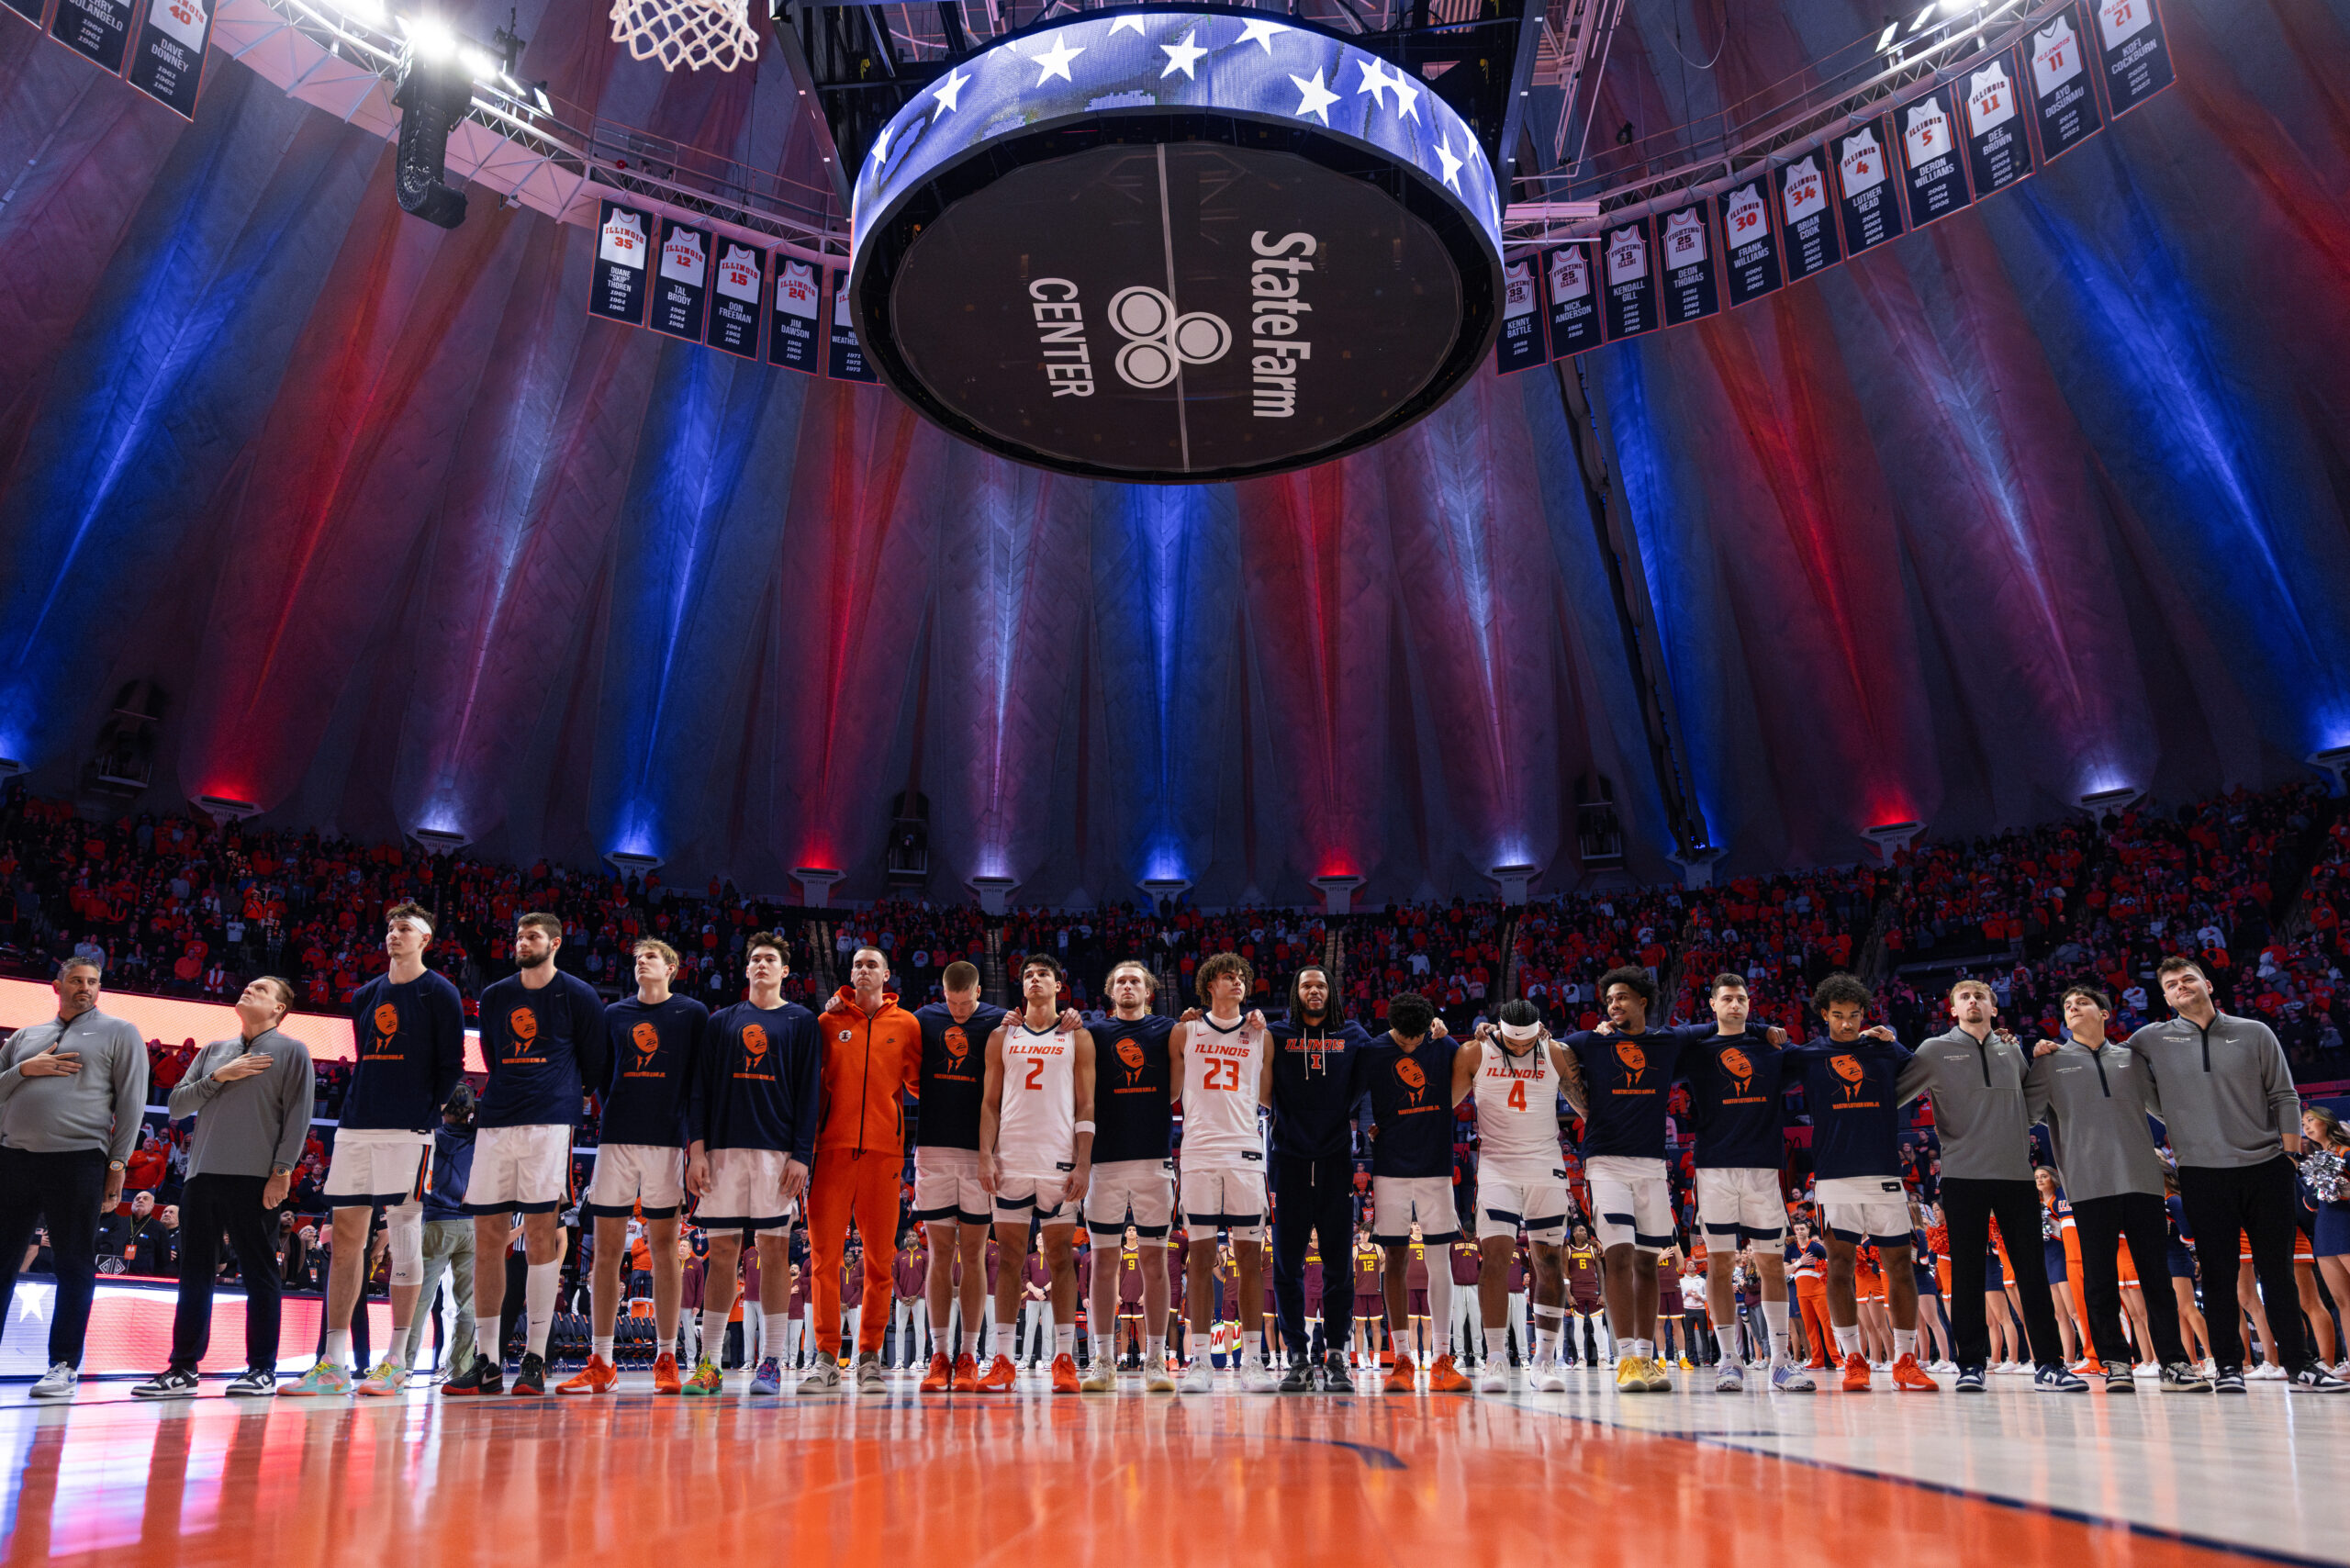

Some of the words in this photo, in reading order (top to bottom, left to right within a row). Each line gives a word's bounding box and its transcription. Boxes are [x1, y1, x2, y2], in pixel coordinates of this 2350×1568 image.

[169, 6, 191, 25] 40
[2113, 4, 2132, 28] 21
[161, 38, 184, 59] DAVE
[2037, 37, 2070, 63] ILLINOIS
[2122, 38, 2142, 57] KOFI
[151, 43, 188, 73] DOWNEY
[2049, 51, 2064, 73] 11
[2111, 39, 2157, 75] COCKBURN
[1973, 81, 2005, 104] ILLINOIS
[2055, 84, 2070, 102] AYO
[1981, 94, 2000, 116] 11
[2045, 86, 2085, 118] DOSUNMU
[1909, 117, 1942, 138] ILLINOIS
[1988, 127, 2004, 143] DEE
[1922, 129, 1933, 147] 5
[1983, 132, 2012, 156] BROWN
[1844, 147, 1875, 167] ILLINOIS
[1856, 161, 1869, 175] 4
[1919, 157, 1946, 177] DERON
[1914, 163, 1954, 188] WILLIAMS
[1787, 174, 1817, 195] ILLINOIS
[1792, 185, 1817, 207] 34
[1852, 185, 1882, 207] LUTHER
[1730, 202, 1760, 220] ILLINOIS
[1859, 197, 1879, 214] HEAD
[1735, 212, 1757, 232] 30
[1797, 215, 1819, 232] BRIAN
[606, 227, 644, 244] ILLINOIS
[1668, 227, 1699, 241] FIGHTING
[1677, 234, 1692, 245] 25
[1799, 224, 1819, 241] COOK
[614, 237, 632, 250] 35
[1611, 244, 1641, 257] FIGHTING
[1675, 242, 1695, 253] ILLINI
[1739, 241, 1762, 257] FRANK
[666, 245, 702, 263] ILLINOIS
[677, 255, 690, 267] 12
[1620, 252, 1632, 261] 13
[1734, 247, 1769, 269] WILLIAMS
[610, 266, 631, 277] DUANE
[722, 263, 758, 280] ILLINOIS
[1554, 263, 1583, 277] FIGHTING
[1617, 259, 1636, 269] ILLINI
[1678, 265, 1697, 278] DEON
[730, 272, 747, 286] 15
[1561, 271, 1575, 281] 25
[1561, 277, 1578, 288] ILLINI
[1673, 273, 1704, 288] THOMAS
[608, 280, 632, 292] THOREN
[674, 285, 687, 296] TAL
[780, 280, 816, 297] ILLINOIS
[789, 287, 806, 301] 24
[1614, 281, 1645, 296] KENDALL
[667, 292, 691, 306] BRODY
[1622, 292, 1638, 302] GILL
[729, 302, 744, 312] DON
[1564, 300, 1581, 311] NICK
[719, 308, 751, 324] FREEMAN
[1555, 305, 1591, 323] ANDERSON
[790, 319, 801, 329] JIM
[1507, 317, 1530, 330] KENNY
[1507, 325, 1531, 338] BATTLE
[780, 324, 810, 340] DAWSON
[1028, 277, 1095, 398] CENTER
[1009, 1046, 1065, 1056] ILLINOIS
[1194, 1044, 1250, 1058] ILLINOIS
[1285, 1038, 1345, 1050] ILLINOIS
[1024, 1058, 1044, 1091] 2
[1203, 1058, 1239, 1092] 23
[1486, 1068, 1546, 1080] ILLINOIS
[1507, 1080, 1527, 1112] 4
[1416, 1249, 1424, 1260] 3
[1128, 1260, 1136, 1271] 9
[1363, 1260, 1374, 1271] 12
[1579, 1259, 1587, 1270] 6
